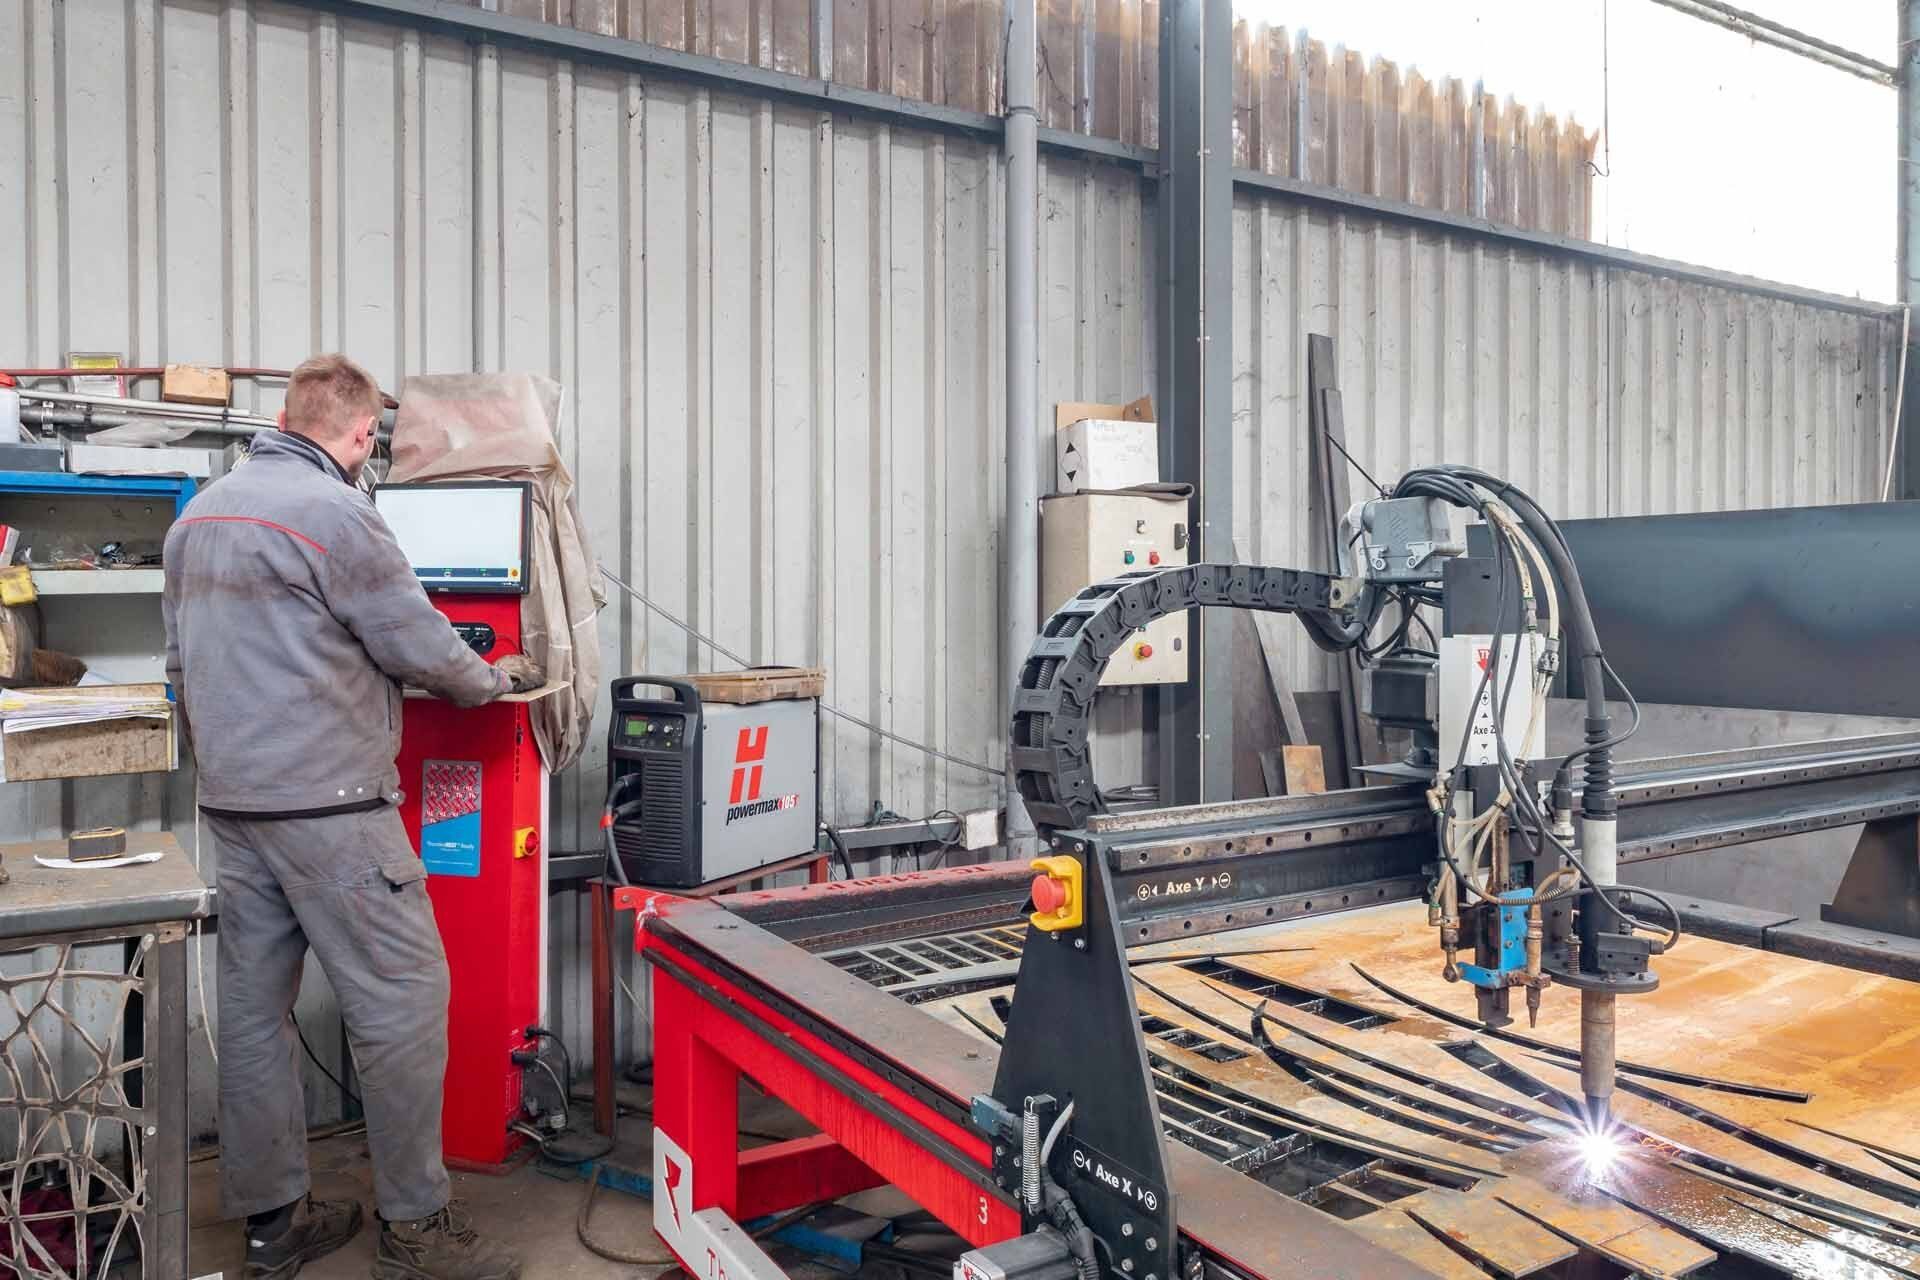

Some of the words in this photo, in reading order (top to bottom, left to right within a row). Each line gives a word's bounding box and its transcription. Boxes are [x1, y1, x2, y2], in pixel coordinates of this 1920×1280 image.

[1473, 725, 1488, 735] Axe
[1490, 724, 1497, 734] Z
[1165, 881, 1191, 896] Axe
[1195, 877, 1206, 891] Y
[1095, 1163, 1120, 1189] Axe
[1121, 1177, 1132, 1197] X
[977, 1196, 988, 1225] 3
